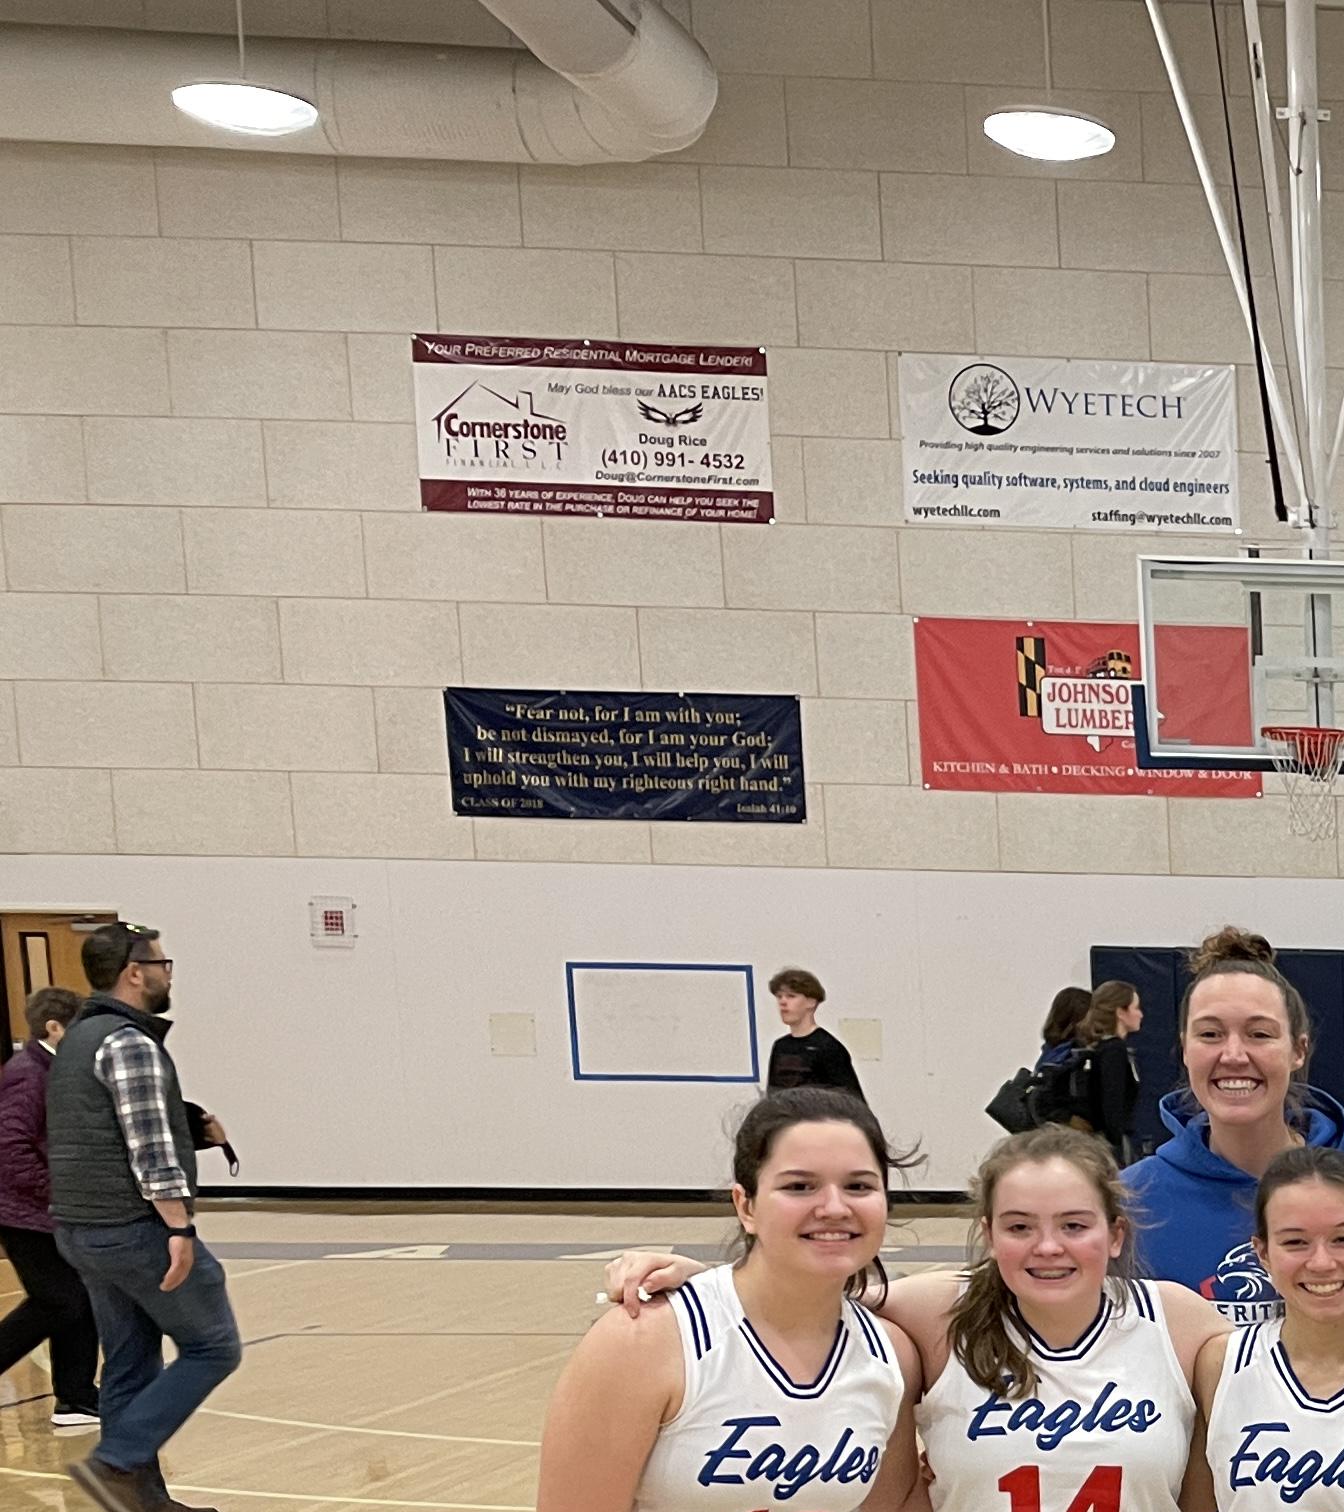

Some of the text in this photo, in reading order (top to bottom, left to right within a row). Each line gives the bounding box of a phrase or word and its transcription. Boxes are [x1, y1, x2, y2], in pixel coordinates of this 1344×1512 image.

[425, 341, 753, 367] YOUR PREFERRED RESIDENTIAL MORTGAGE LENDER!
[658, 384, 763, 400] AACS EAGLES!
[1025, 387, 1183, 419] WYETECH
[444, 413, 567, 441] Cornerstone
[446, 439, 569, 462] FIRST
[639, 433, 707, 447] Doug Rice
[602, 449, 745, 470] (410) 991- 4532
[596, 470, 759, 486] Doug@CornerstoneFirst.com
[912, 470, 1230, 496] Seeking quality software, systems, and cloud engineers
[913, 504, 1000, 519] wyetechllc.com
[1092, 509, 1233, 526] staffing@wyetechllc.com
[1047, 682, 1129, 704] JOHNSO
[505, 704, 741, 727] “Fear not, for I am with you;
[476, 725, 773, 750] be not dismayed, for I am your God;
[464, 747, 788, 772] I will strengthen you, I will help you, I will
[932, 761, 995, 773] KITCHEN
[999, 763, 1009, 774] &
[1013, 763, 1049, 776] BATH
[1062, 765, 1125, 777] DECKING
[464, 769, 516, 788] uphold
[521, 774, 550, 789] you
[555, 772, 588, 787] with
[594, 777, 616, 792] my
[622, 774, 693, 792] righteous
[699, 775, 734, 793] right
[964, 1375, 1162, 1453] Eagles
[696, 1415, 881, 1502] Eagles
